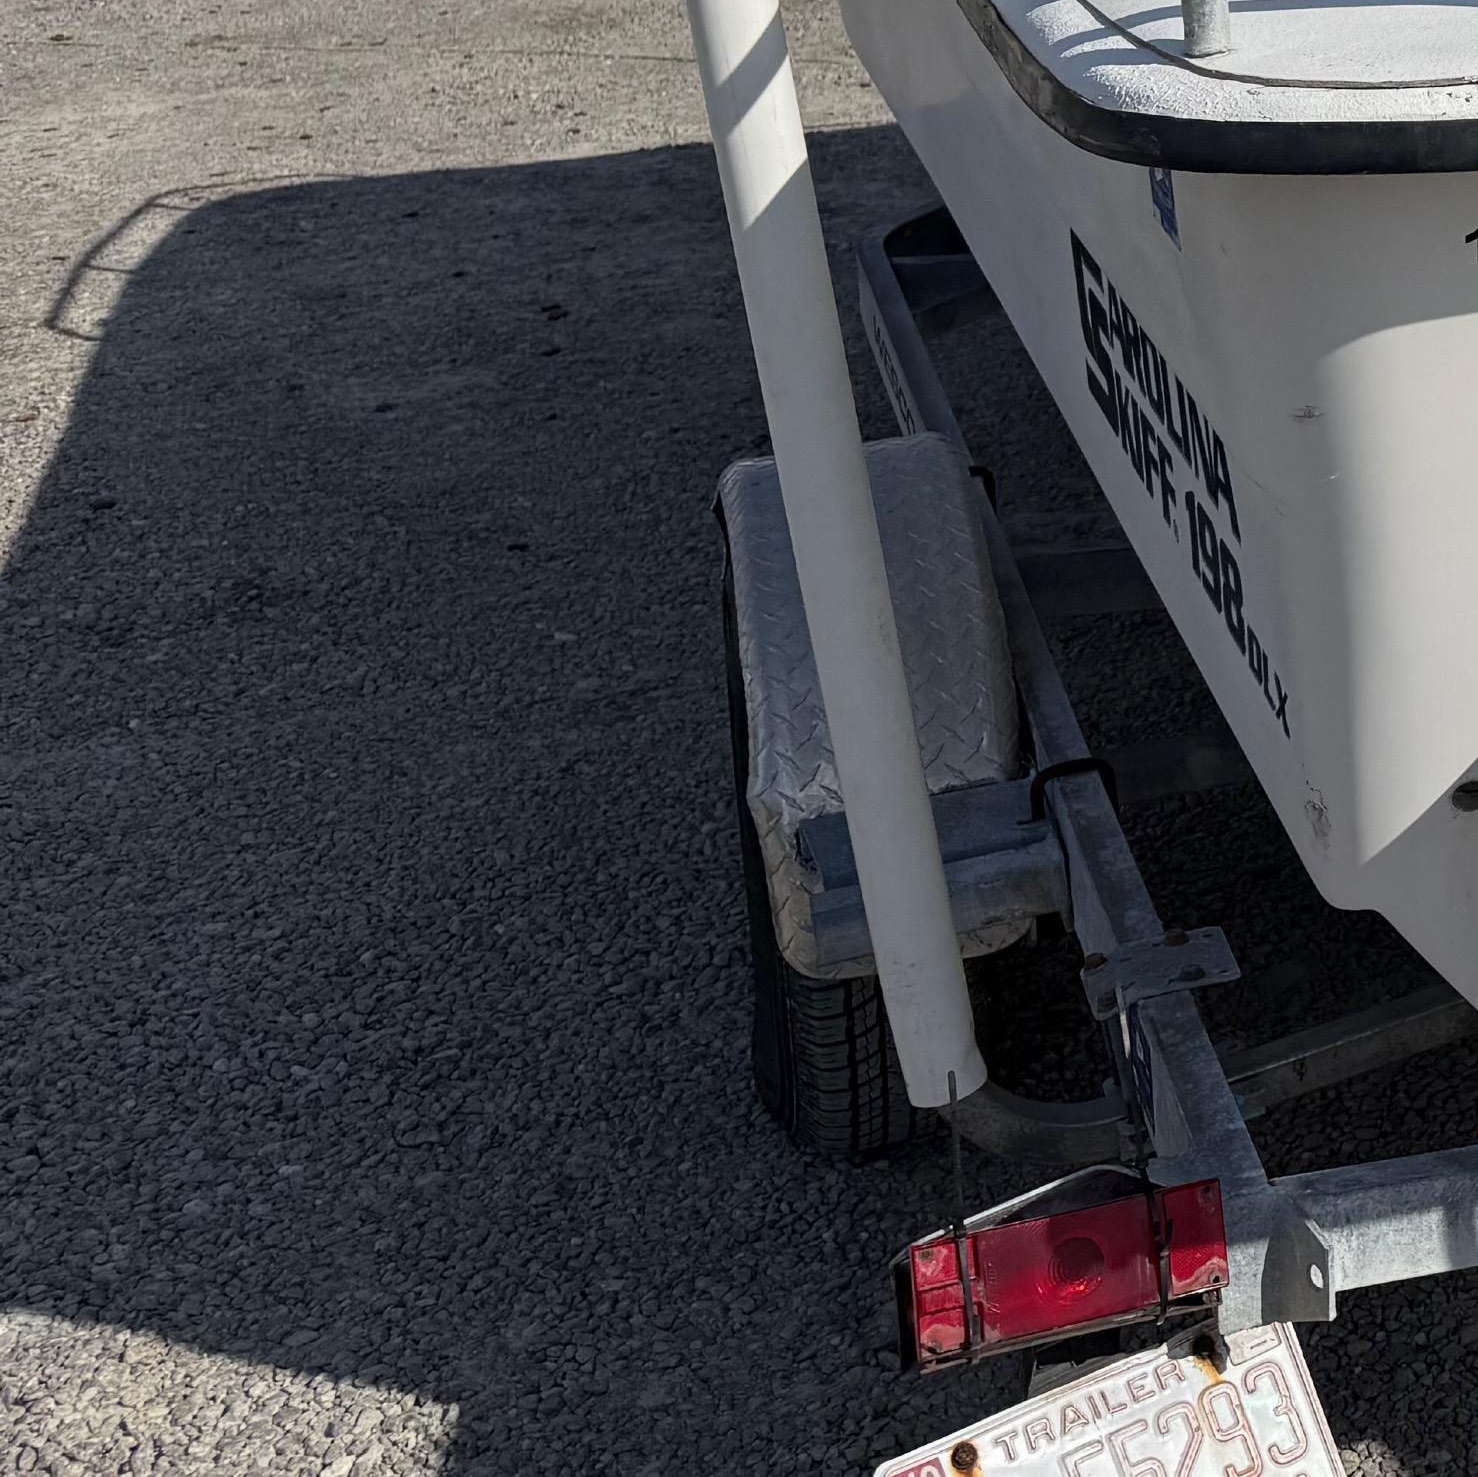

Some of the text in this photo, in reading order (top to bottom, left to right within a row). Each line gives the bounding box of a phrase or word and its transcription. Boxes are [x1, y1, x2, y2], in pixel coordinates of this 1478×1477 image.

[1070, 227, 1242, 546] CAROLINA
[1185, 490, 1246, 656] 198
[1247, 625, 1291, 739] DLX
[994, 1360, 1187, 1464] TRAILER
